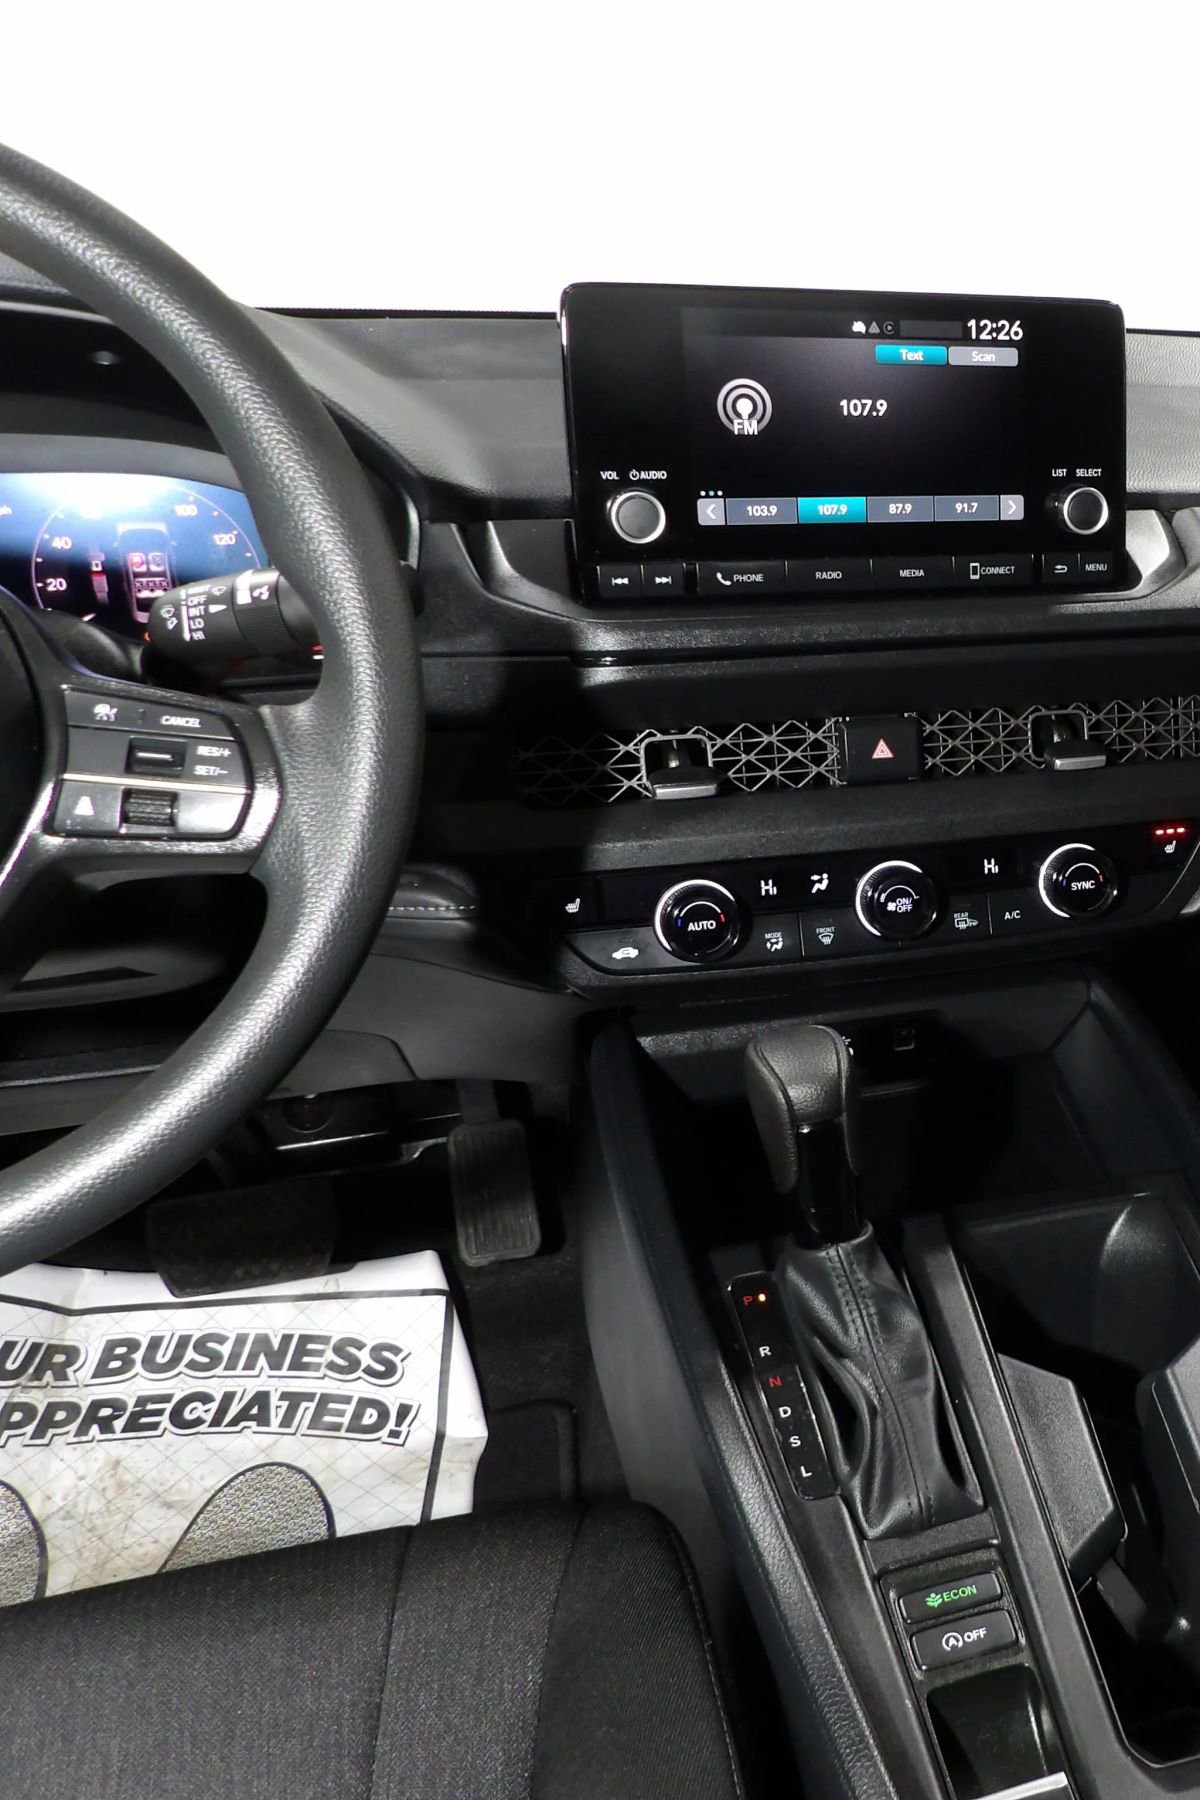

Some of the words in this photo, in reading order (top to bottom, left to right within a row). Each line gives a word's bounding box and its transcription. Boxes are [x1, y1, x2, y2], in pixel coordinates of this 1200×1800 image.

[967, 319, 1023, 340] 12:26
[900, 348, 924, 361] Text
[971, 351, 996, 363] Scan
[839, 399, 888, 417] 107.9
[733, 419, 758, 435] FM
[600, 471, 620, 480] VOL
[640, 471, 667, 480] AUDIO
[1052, 468, 1067, 477] LIST
[1076, 468, 1102, 477] SELECT
[746, 505, 778, 517] 103.9
[817, 503, 848, 516] 107.9
[888, 503, 912, 515] 87.9
[955, 502, 978, 514] 91.7
[52, 536, 72, 550] 40
[213, 533, 236, 546] 120
[900, 569, 925, 578] MEDIA
[980, 566, 1015, 576] CONNECT
[1085, 563, 1108, 572] MENU
[733, 573, 765, 583] PHONE
[816, 571, 843, 580] RADIO
[46, 578, 67, 592] 20
[187, 595, 207, 606] OFF
[188, 605, 206, 617] INT
[189, 618, 205, 629] LO
[160, 715, 202, 728] CANCEL
[1071, 880, 1096, 891] SYNC
[896, 896, 913, 905] ON/
[896, 903, 913, 913] OFF
[953, 911, 969, 919] REAR
[1004, 910, 1021, 920] A/C
[687, 919, 717, 932] AUTO
[816, 926, 836, 934] FRONT
[764, 931, 782, 940] MODE
[743, 1295, 753, 1306] P
[758, 1345, 772, 1357] R
[92, 1331, 408, 1384] BUSINESS
[768, 1375, 783, 1387] N
[779, 1406, 792, 1418] D
[789, 1435, 802, 1448] S
[801, 1465, 813, 1478] L
[943, 1585, 977, 1602] ECON
[964, 1627, 987, 1642] OFF
